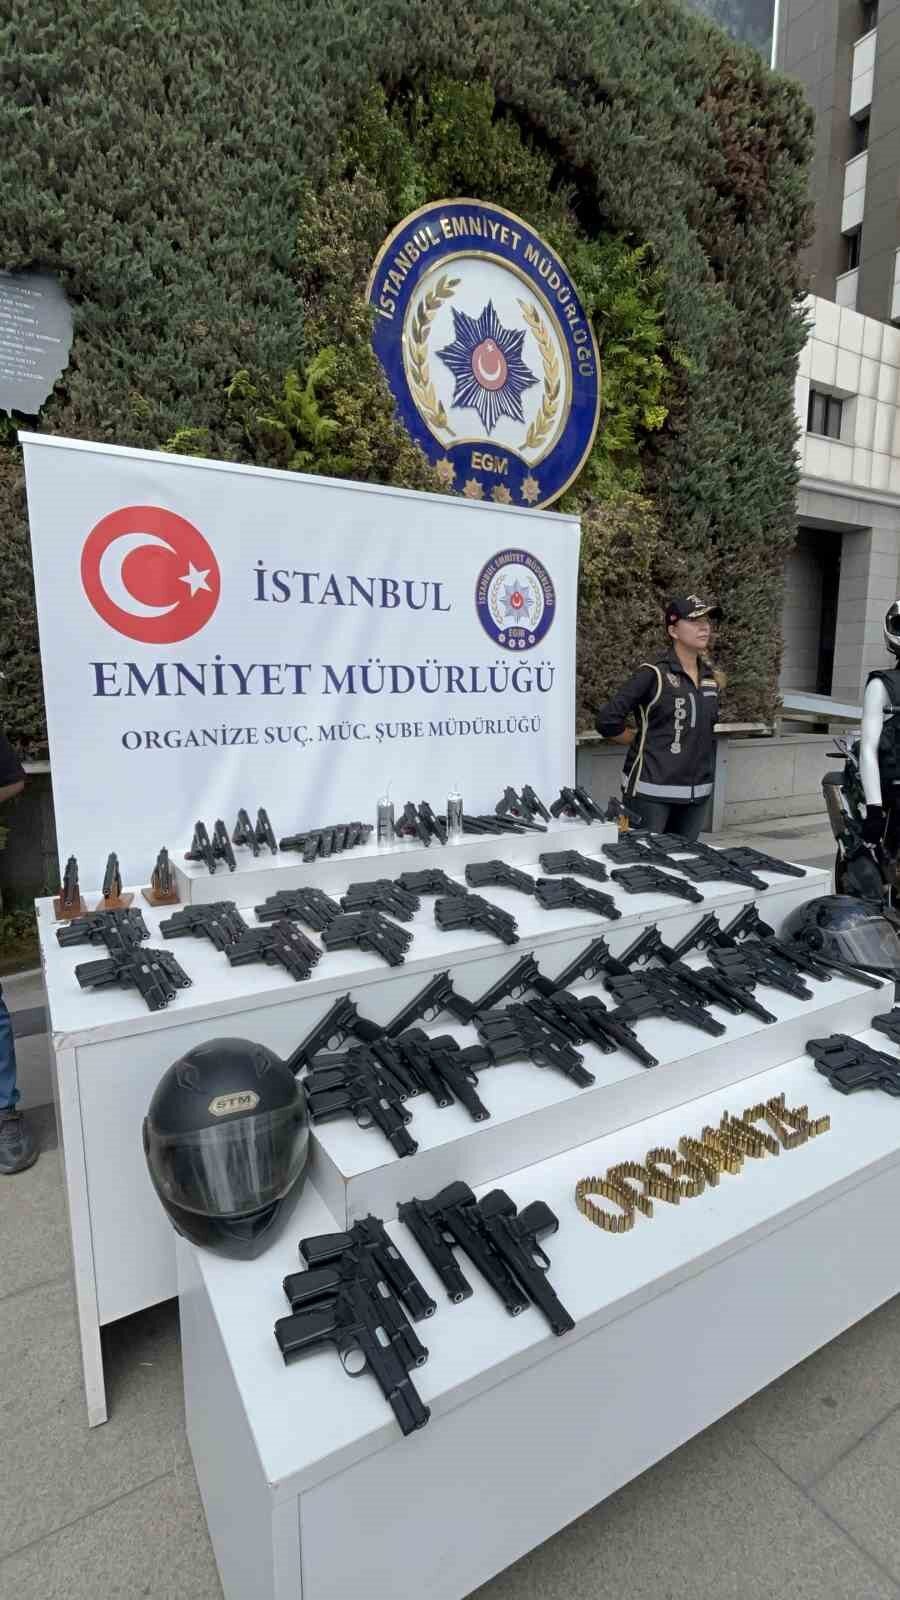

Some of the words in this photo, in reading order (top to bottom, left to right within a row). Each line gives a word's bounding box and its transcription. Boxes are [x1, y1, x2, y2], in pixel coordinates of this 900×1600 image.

[374, 227, 440, 319] İSTANBUL
[440, 215, 522, 249] EMNİYET
[524, 243, 593, 378] MÜDÜRLÜĞÜ
[471, 451, 508, 475] EGM
[252, 559, 453, 613] İSTANBUL
[89, 654, 312, 697] EMNİYET
[321, 658, 555, 695] MÜDÜRLÜĞÜ
[121, 723, 259, 750] ORGANİZE
[264, 724, 313, 747] SUÇ.
[318, 720, 370, 742] MÜC.
[375, 721, 425, 743] ŞUBE
[428, 714, 542, 737] MÜDÜRLÜĞÜ
[216, 1095, 251, 1109] STM
